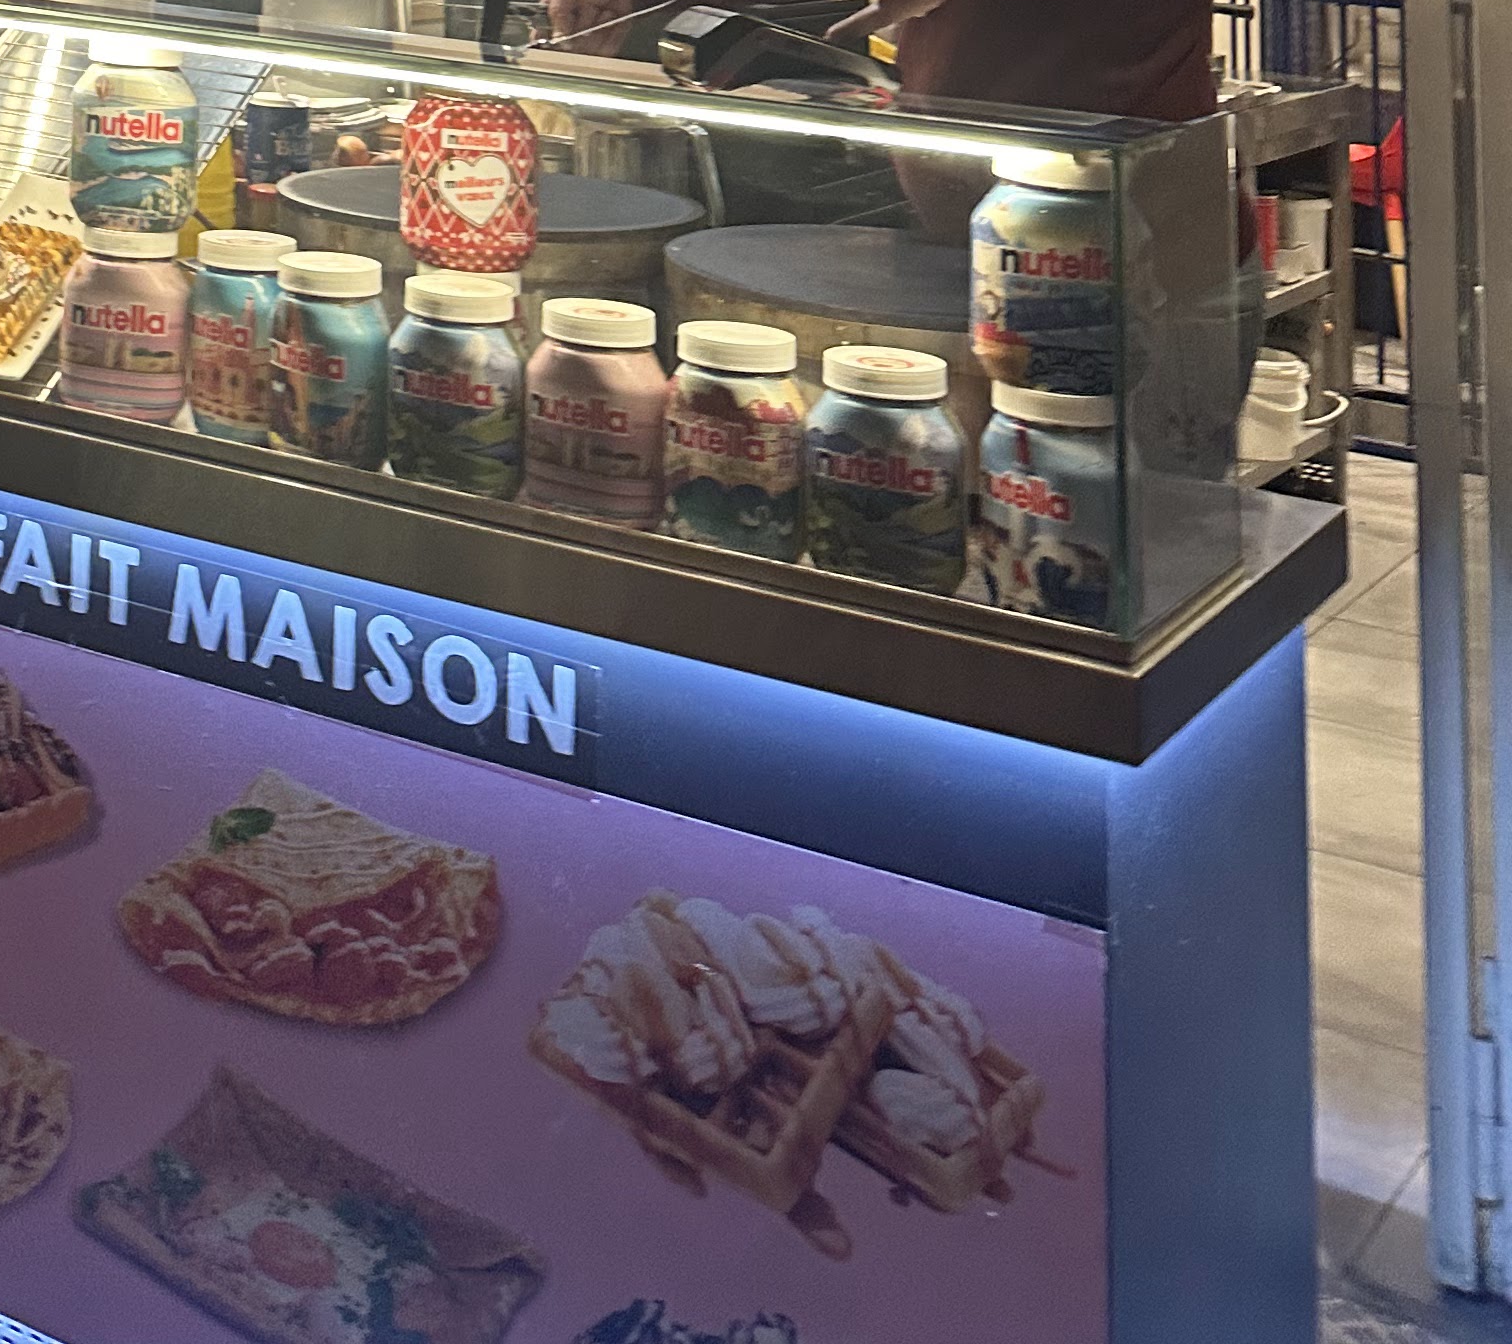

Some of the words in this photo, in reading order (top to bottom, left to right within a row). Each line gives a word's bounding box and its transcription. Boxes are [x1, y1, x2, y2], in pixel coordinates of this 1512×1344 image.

[85, 111, 183, 143] nutella
[70, 303, 168, 336] nutella
[193, 313, 251, 349] utella
[395, 366, 494, 408] nutella
[532, 393, 628, 436] nutella
[667, 415, 766, 462] nutella
[814, 448, 933, 494] nutella
[990, 471, 1071, 521] utella
[167, 562, 577, 756] MAISON
